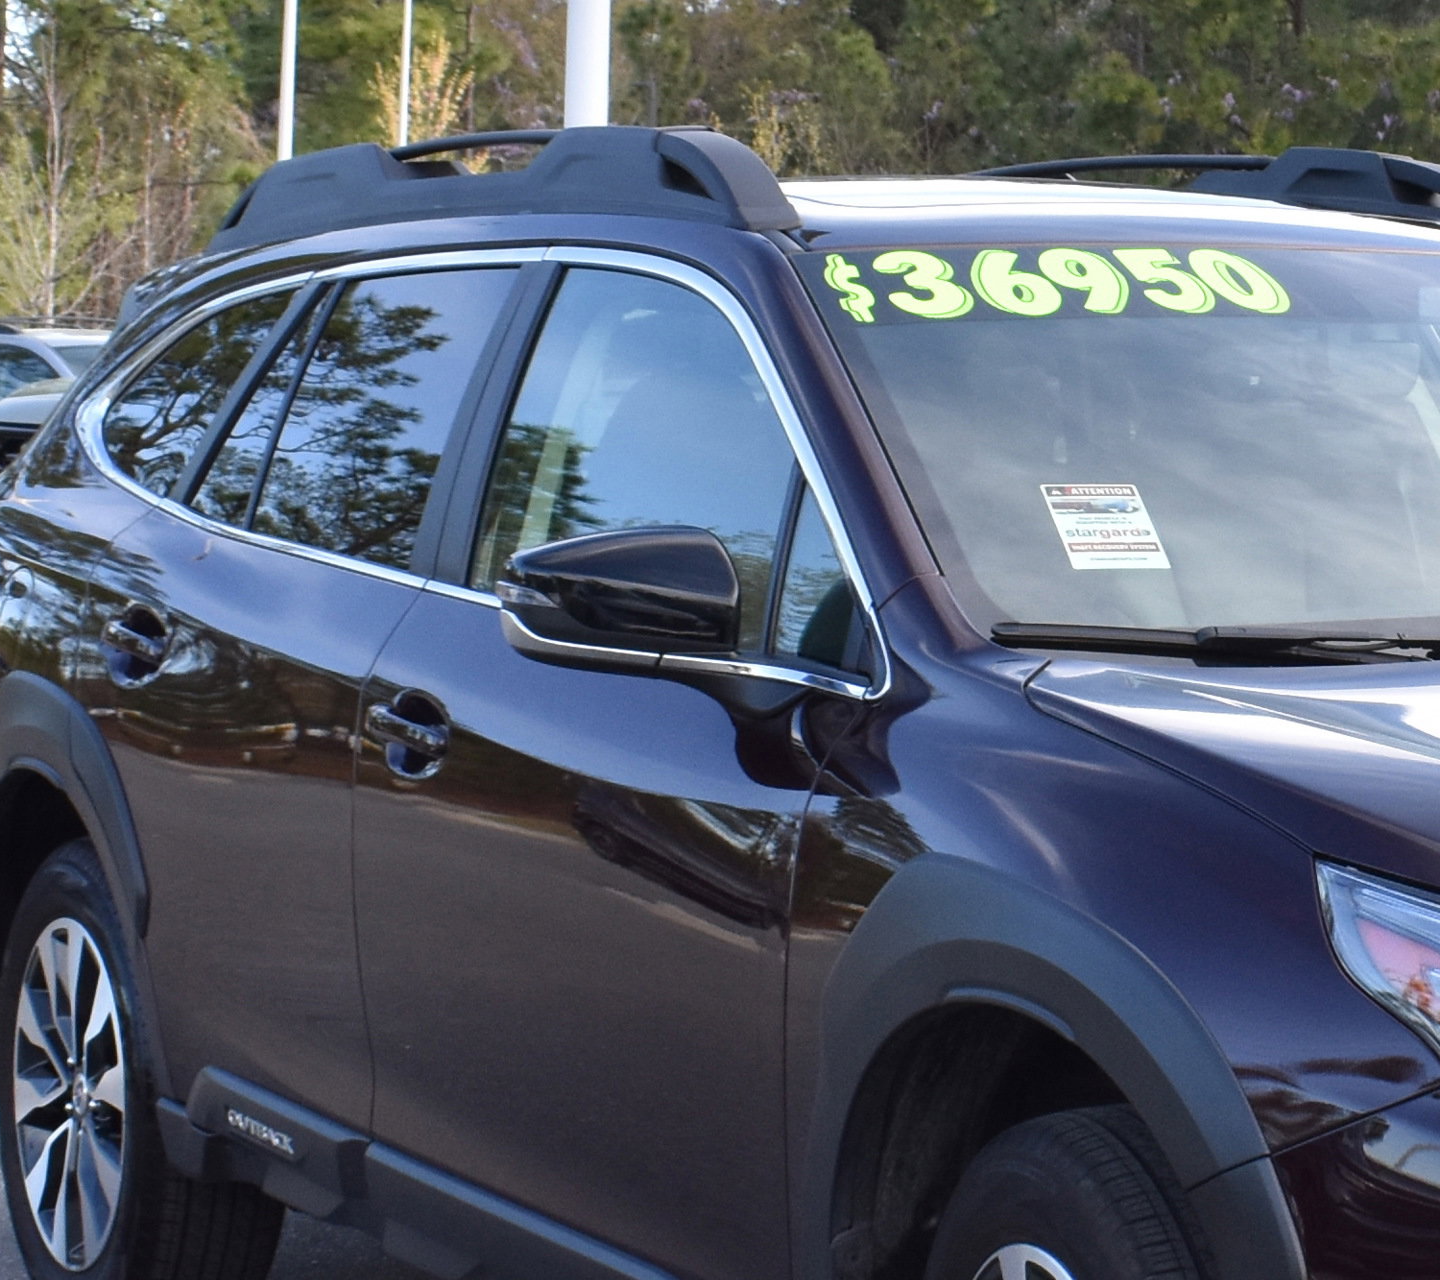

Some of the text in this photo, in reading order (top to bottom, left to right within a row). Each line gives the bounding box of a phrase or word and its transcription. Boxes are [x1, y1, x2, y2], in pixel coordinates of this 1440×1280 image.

[823, 247, 1291, 323] $36950
[1070, 486, 1133, 496] ATTENTION
[227, 1108, 295, 1155] OUTBACK
